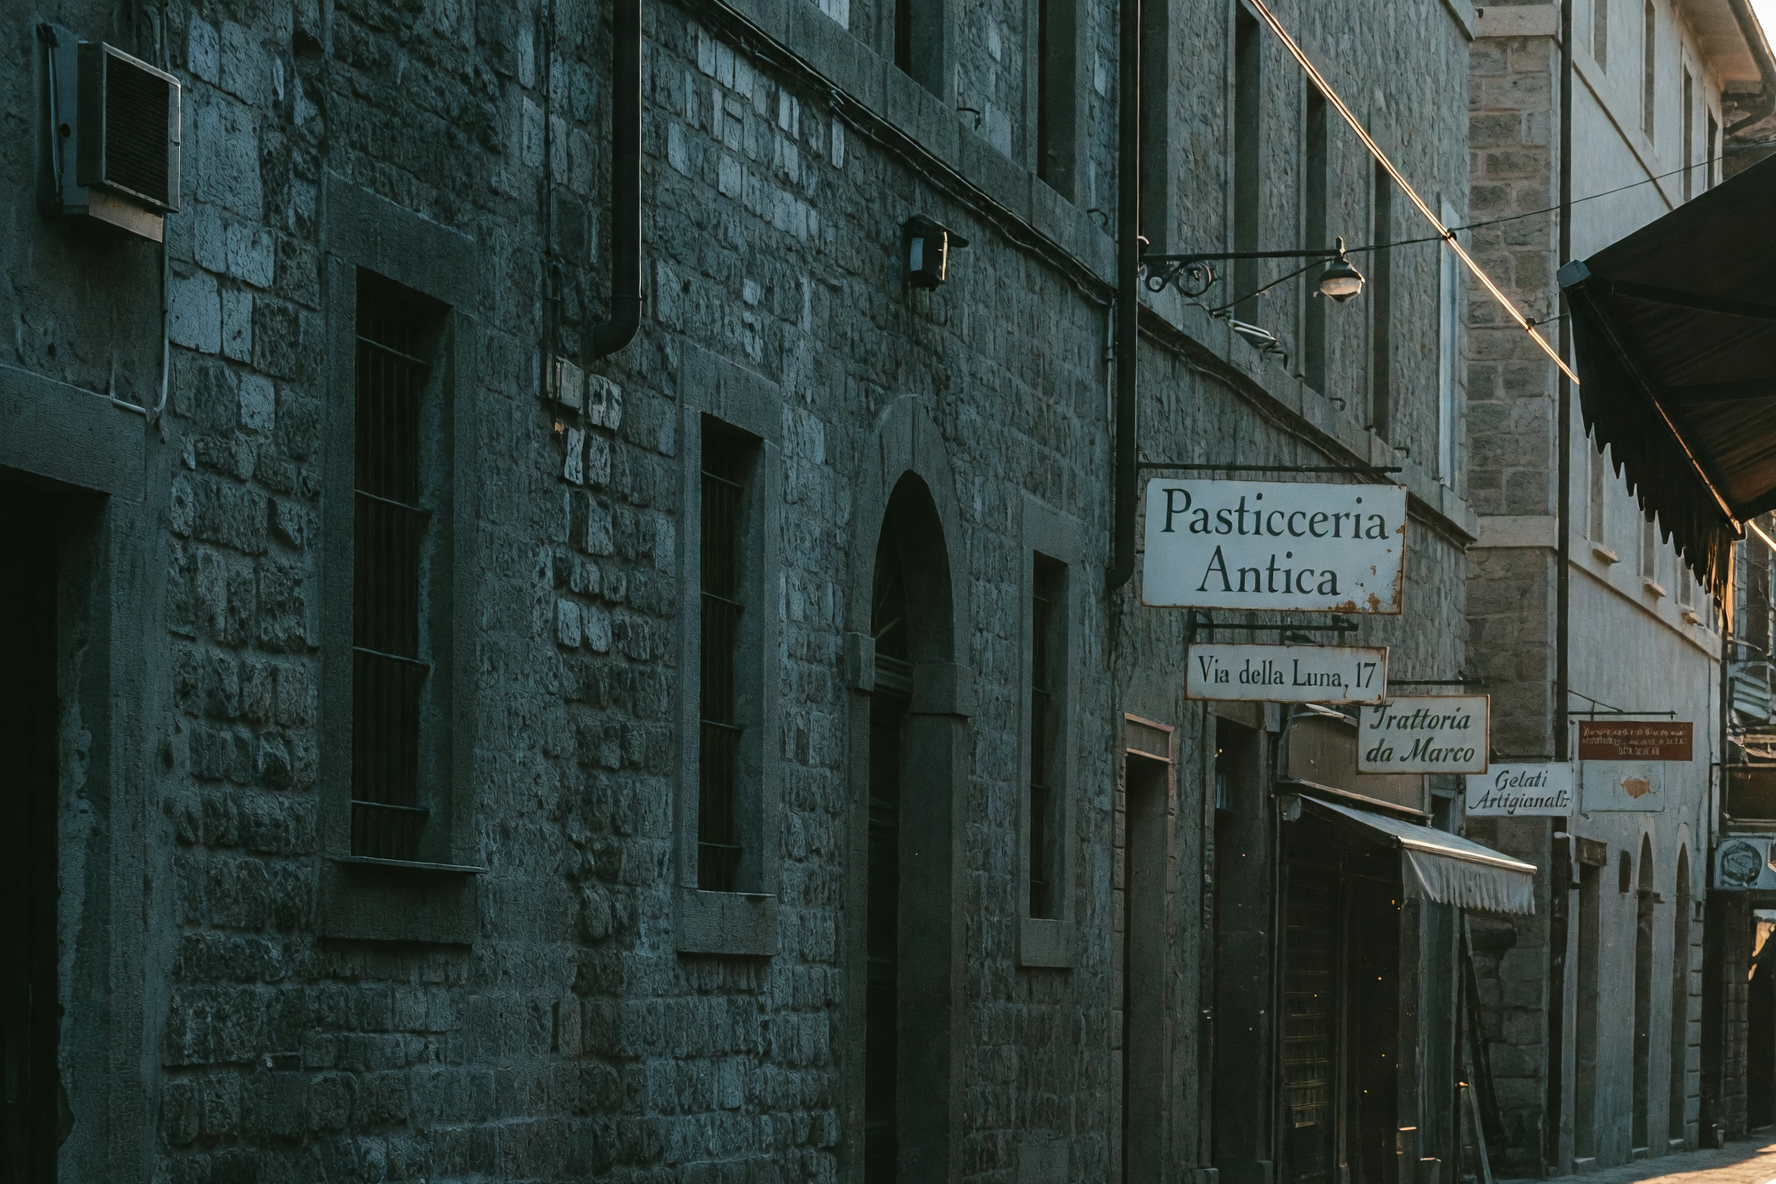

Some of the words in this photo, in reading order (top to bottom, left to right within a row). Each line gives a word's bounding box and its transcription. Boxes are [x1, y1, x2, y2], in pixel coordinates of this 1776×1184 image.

[1160, 488, 1389, 540] Pasticceria
[1195, 544, 1341, 596] Antica
[1198, 655, 1230, 684] Via
[1239, 659, 1285, 685] della
[1292, 659, 1349, 698] Luna,
[1355, 661, 1377, 689] 17
[1369, 701, 1471, 730] Trattoria
[1366, 738, 1394, 763] da
[1399, 737, 1475, 763] Marco
[1495, 770, 1548, 792] Gelati
